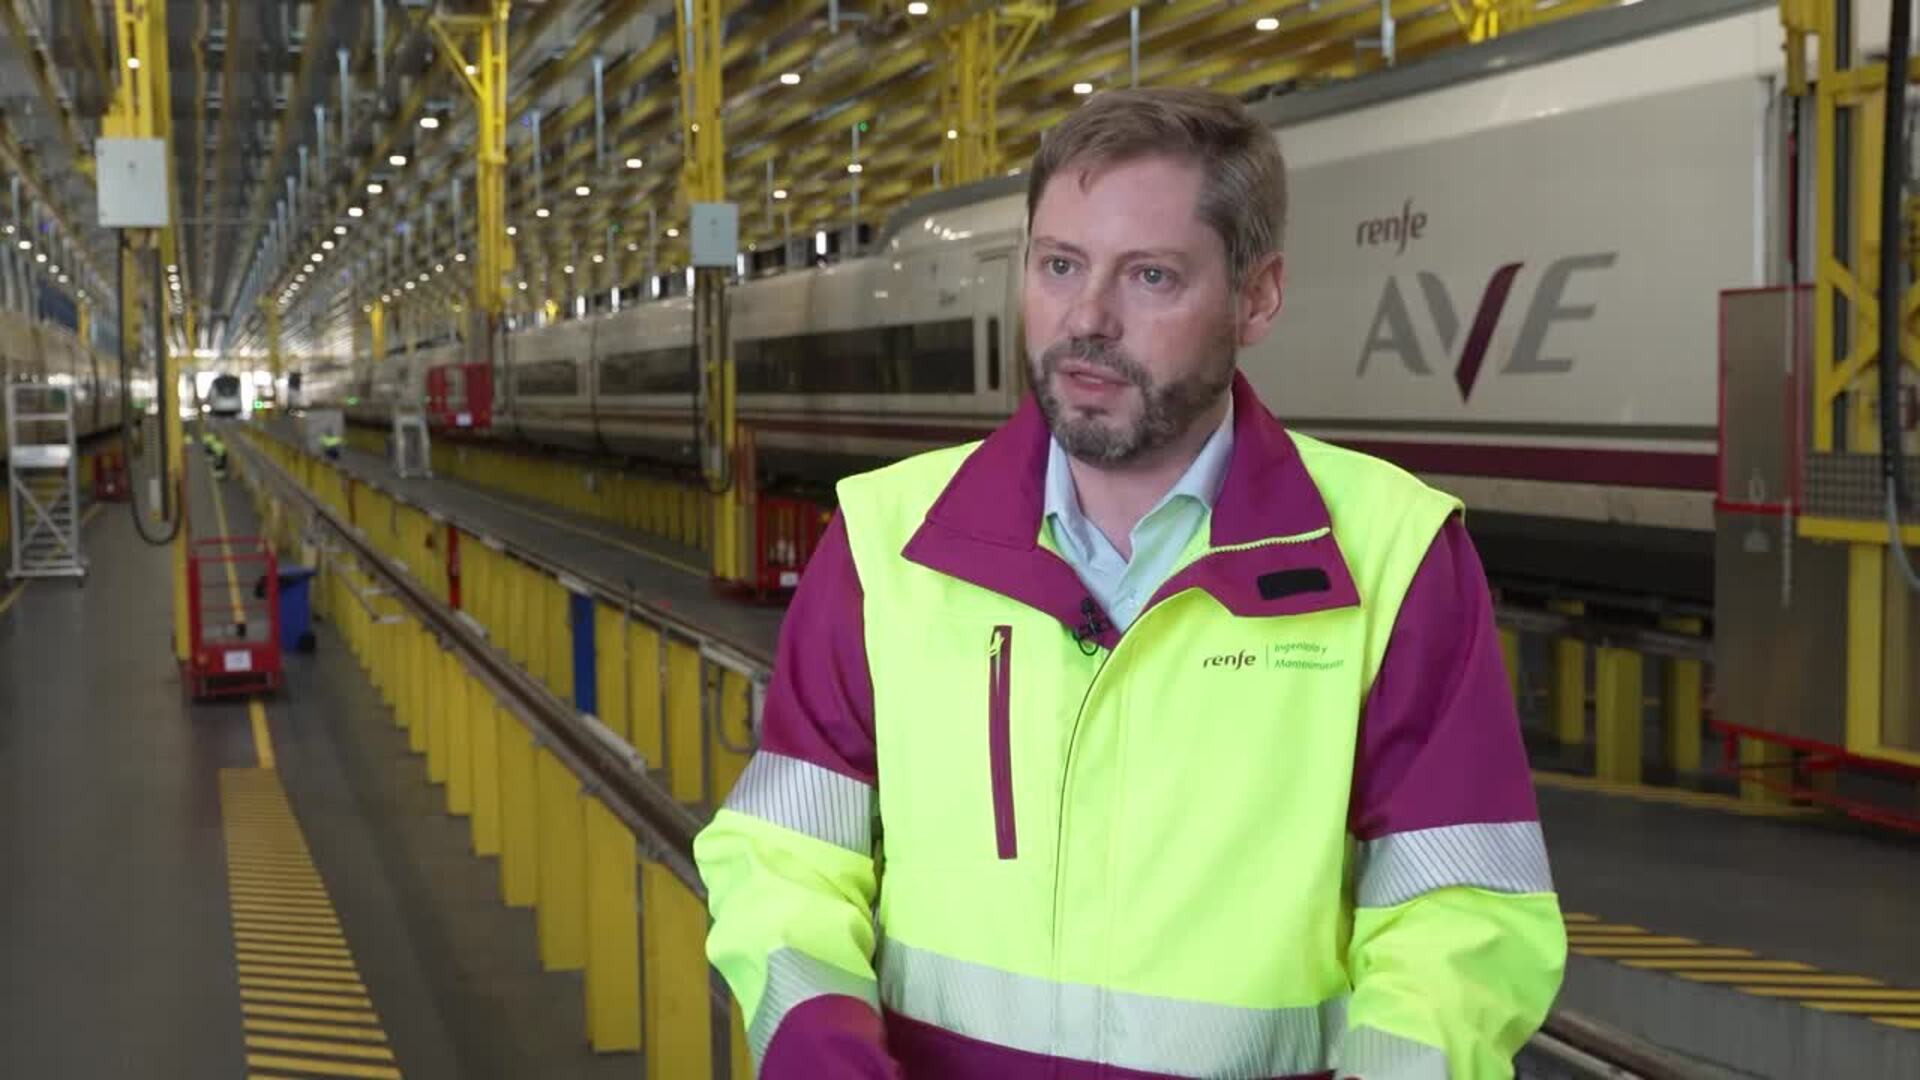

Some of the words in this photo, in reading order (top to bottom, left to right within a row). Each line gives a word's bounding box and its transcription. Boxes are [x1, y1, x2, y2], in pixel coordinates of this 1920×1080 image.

[1355, 196, 1428, 255] renfe
[1355, 252, 1619, 405] AVE
[1203, 649, 1257, 671] renfe
